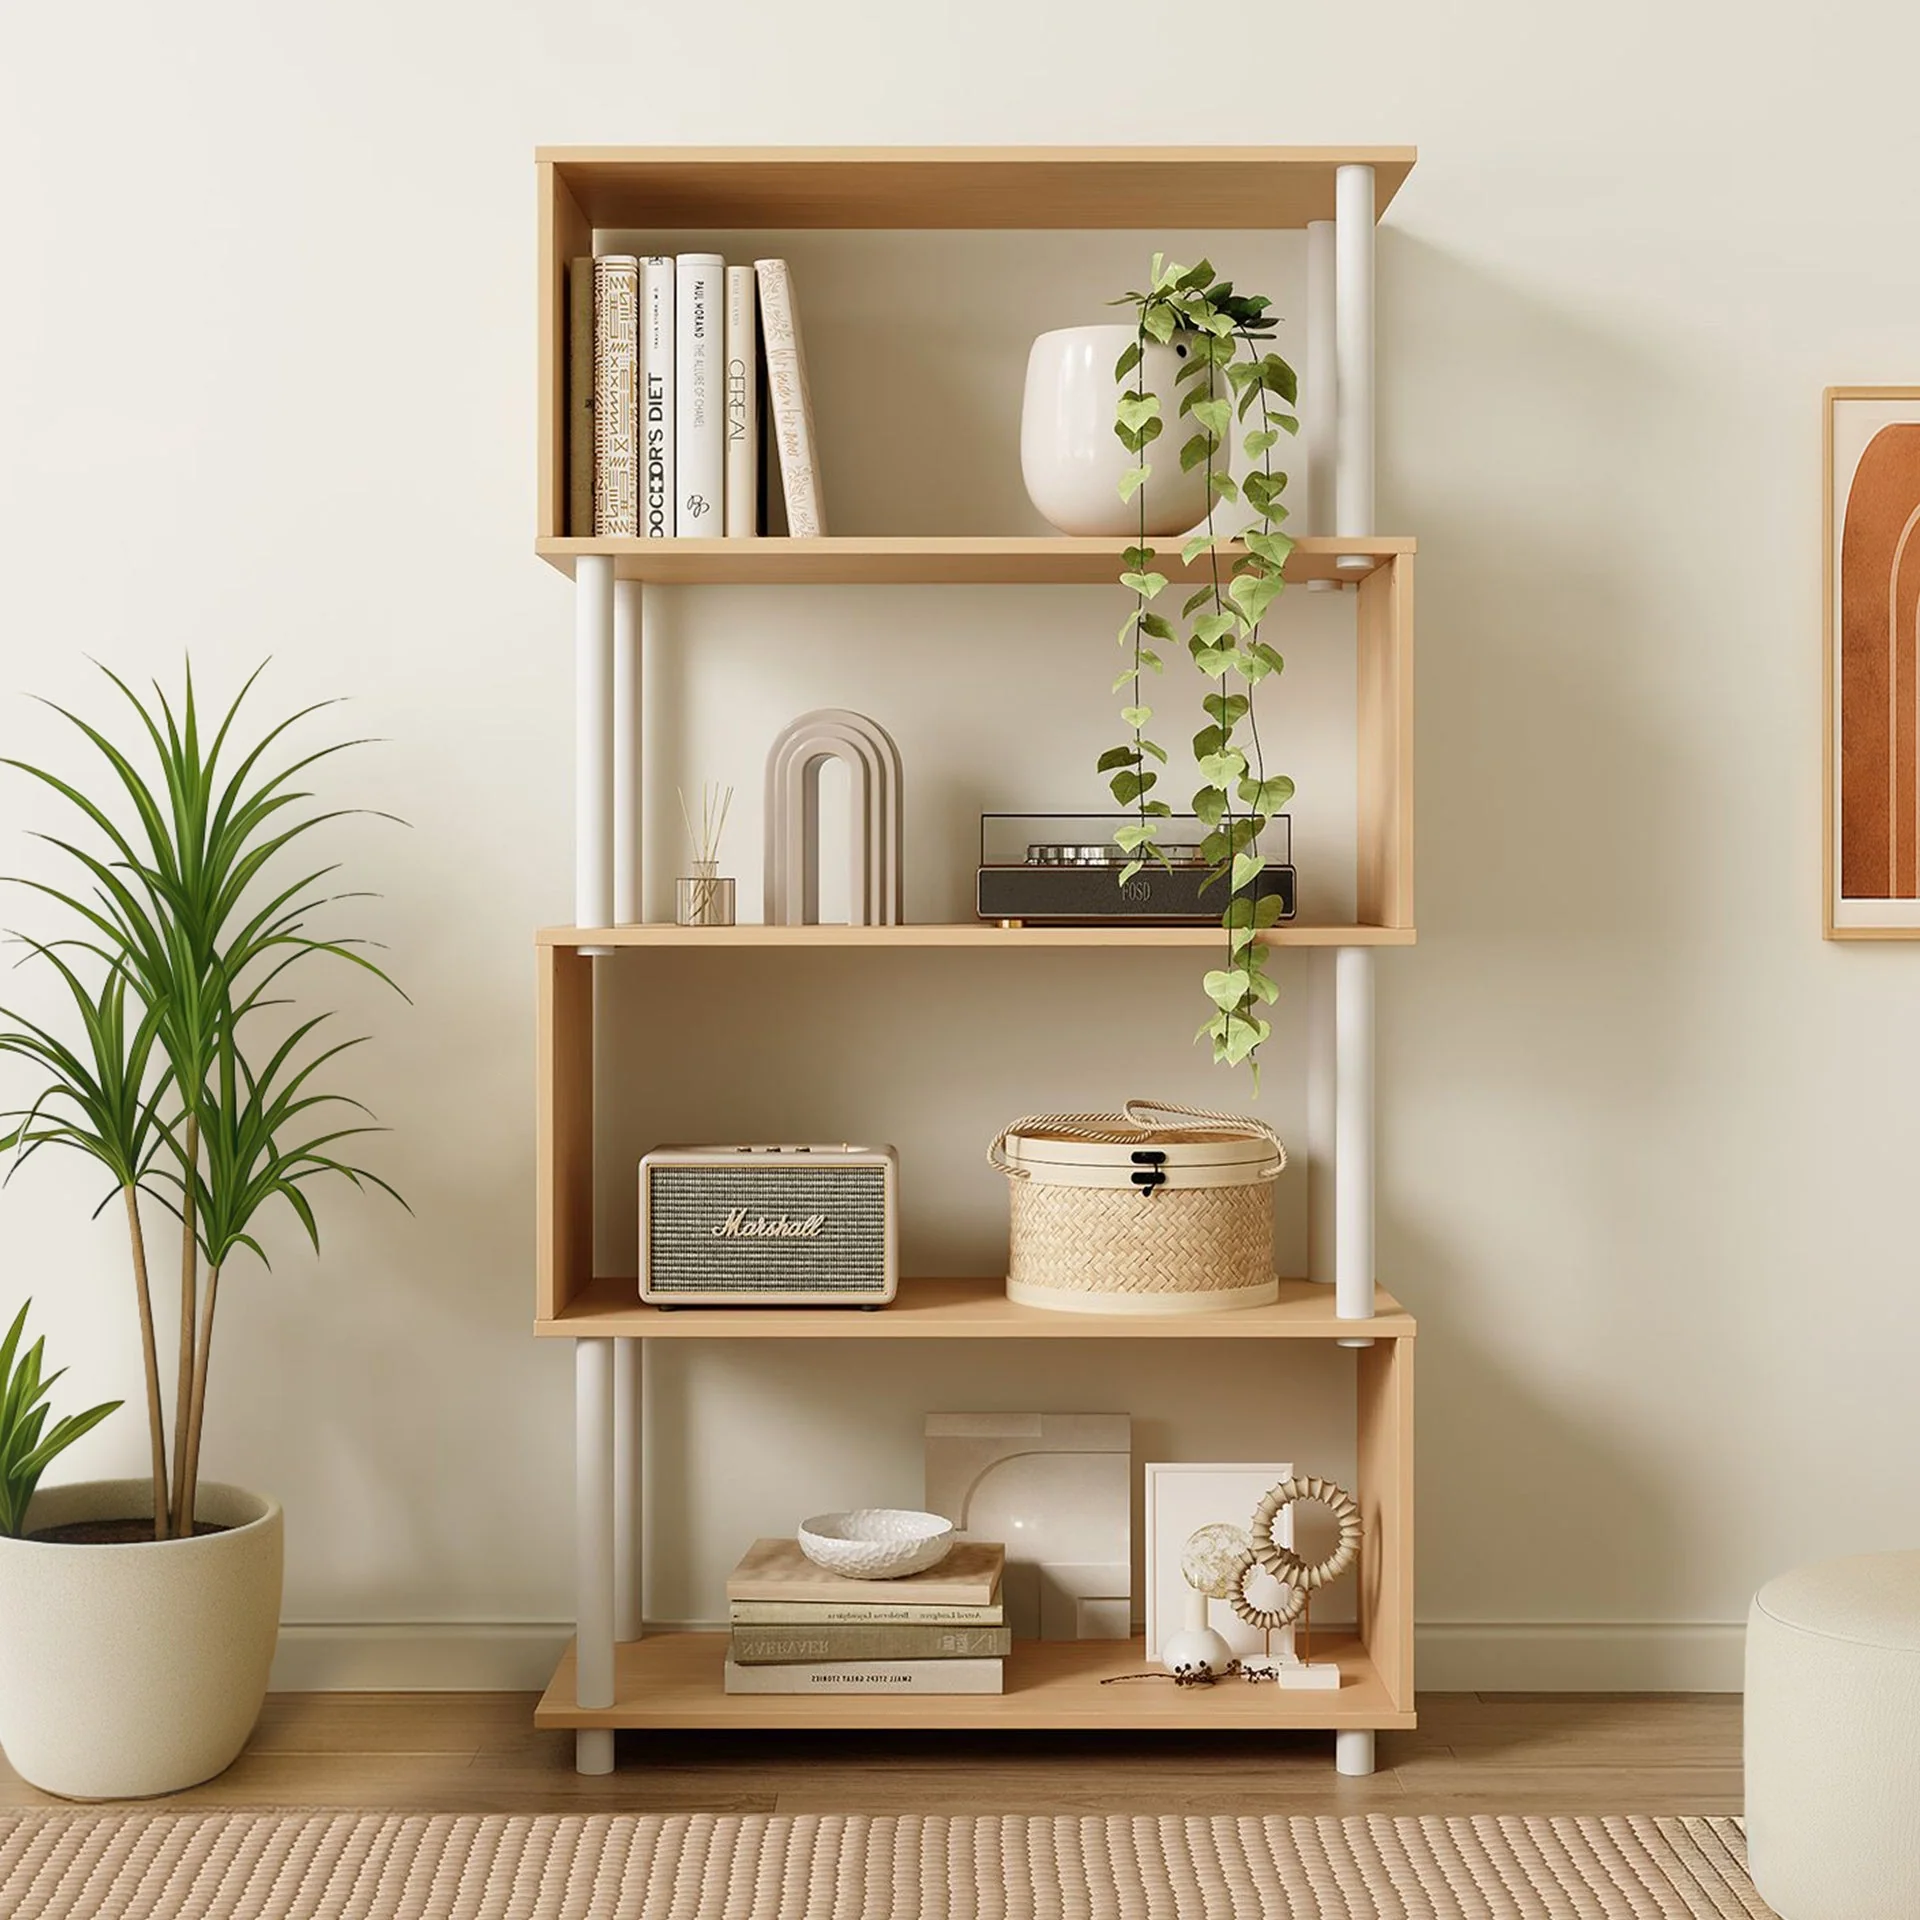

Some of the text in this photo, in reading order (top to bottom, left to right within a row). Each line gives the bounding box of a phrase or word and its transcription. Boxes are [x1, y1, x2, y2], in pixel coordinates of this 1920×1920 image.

[694, 280, 704, 300] PAUL
[694, 303, 704, 339] MORAND
[694, 360, 705, 385] ALLURE
[648, 372, 663, 422] DIET
[729, 359, 746, 452] CEREAL
[694, 398, 705, 428] CHANEL
[712, 1207, 829, 1238] Marshall
